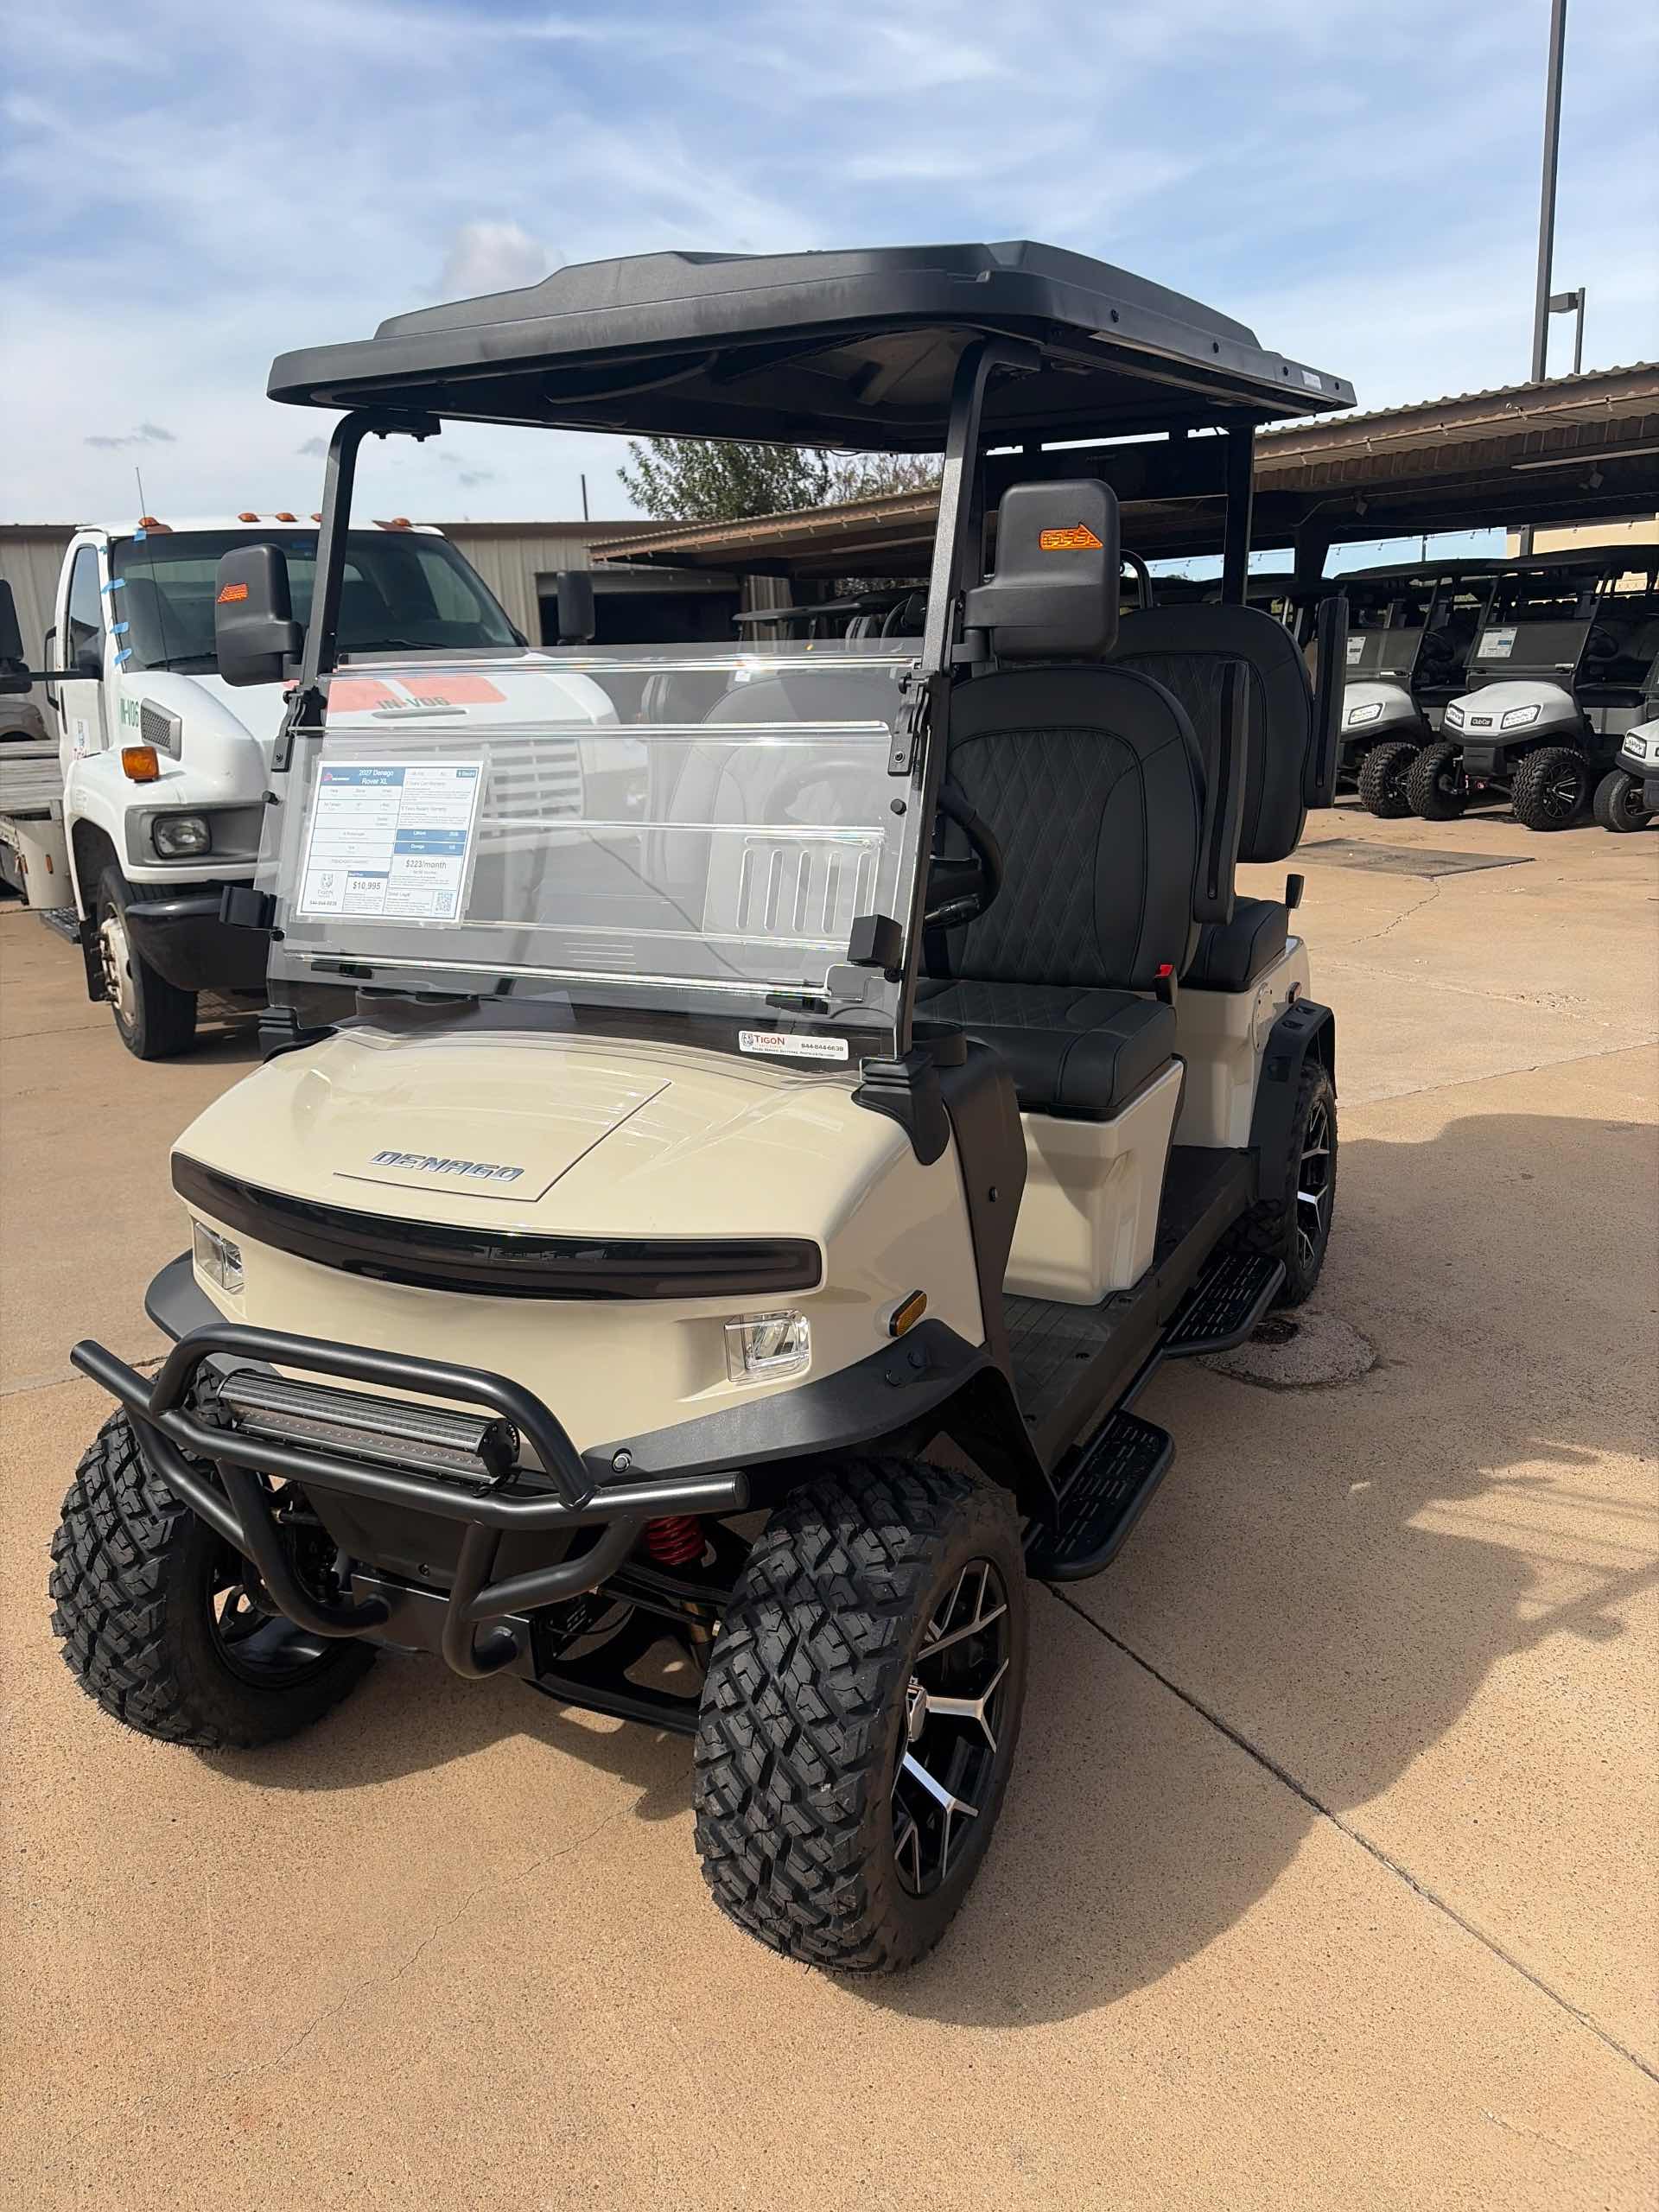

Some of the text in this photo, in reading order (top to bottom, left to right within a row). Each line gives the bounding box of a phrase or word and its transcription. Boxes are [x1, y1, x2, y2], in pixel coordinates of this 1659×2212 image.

[353, 881, 381, 891] $10,995
[753, 1034, 785, 1046] TIGON
[369, 1150, 525, 1182] DENAGO
